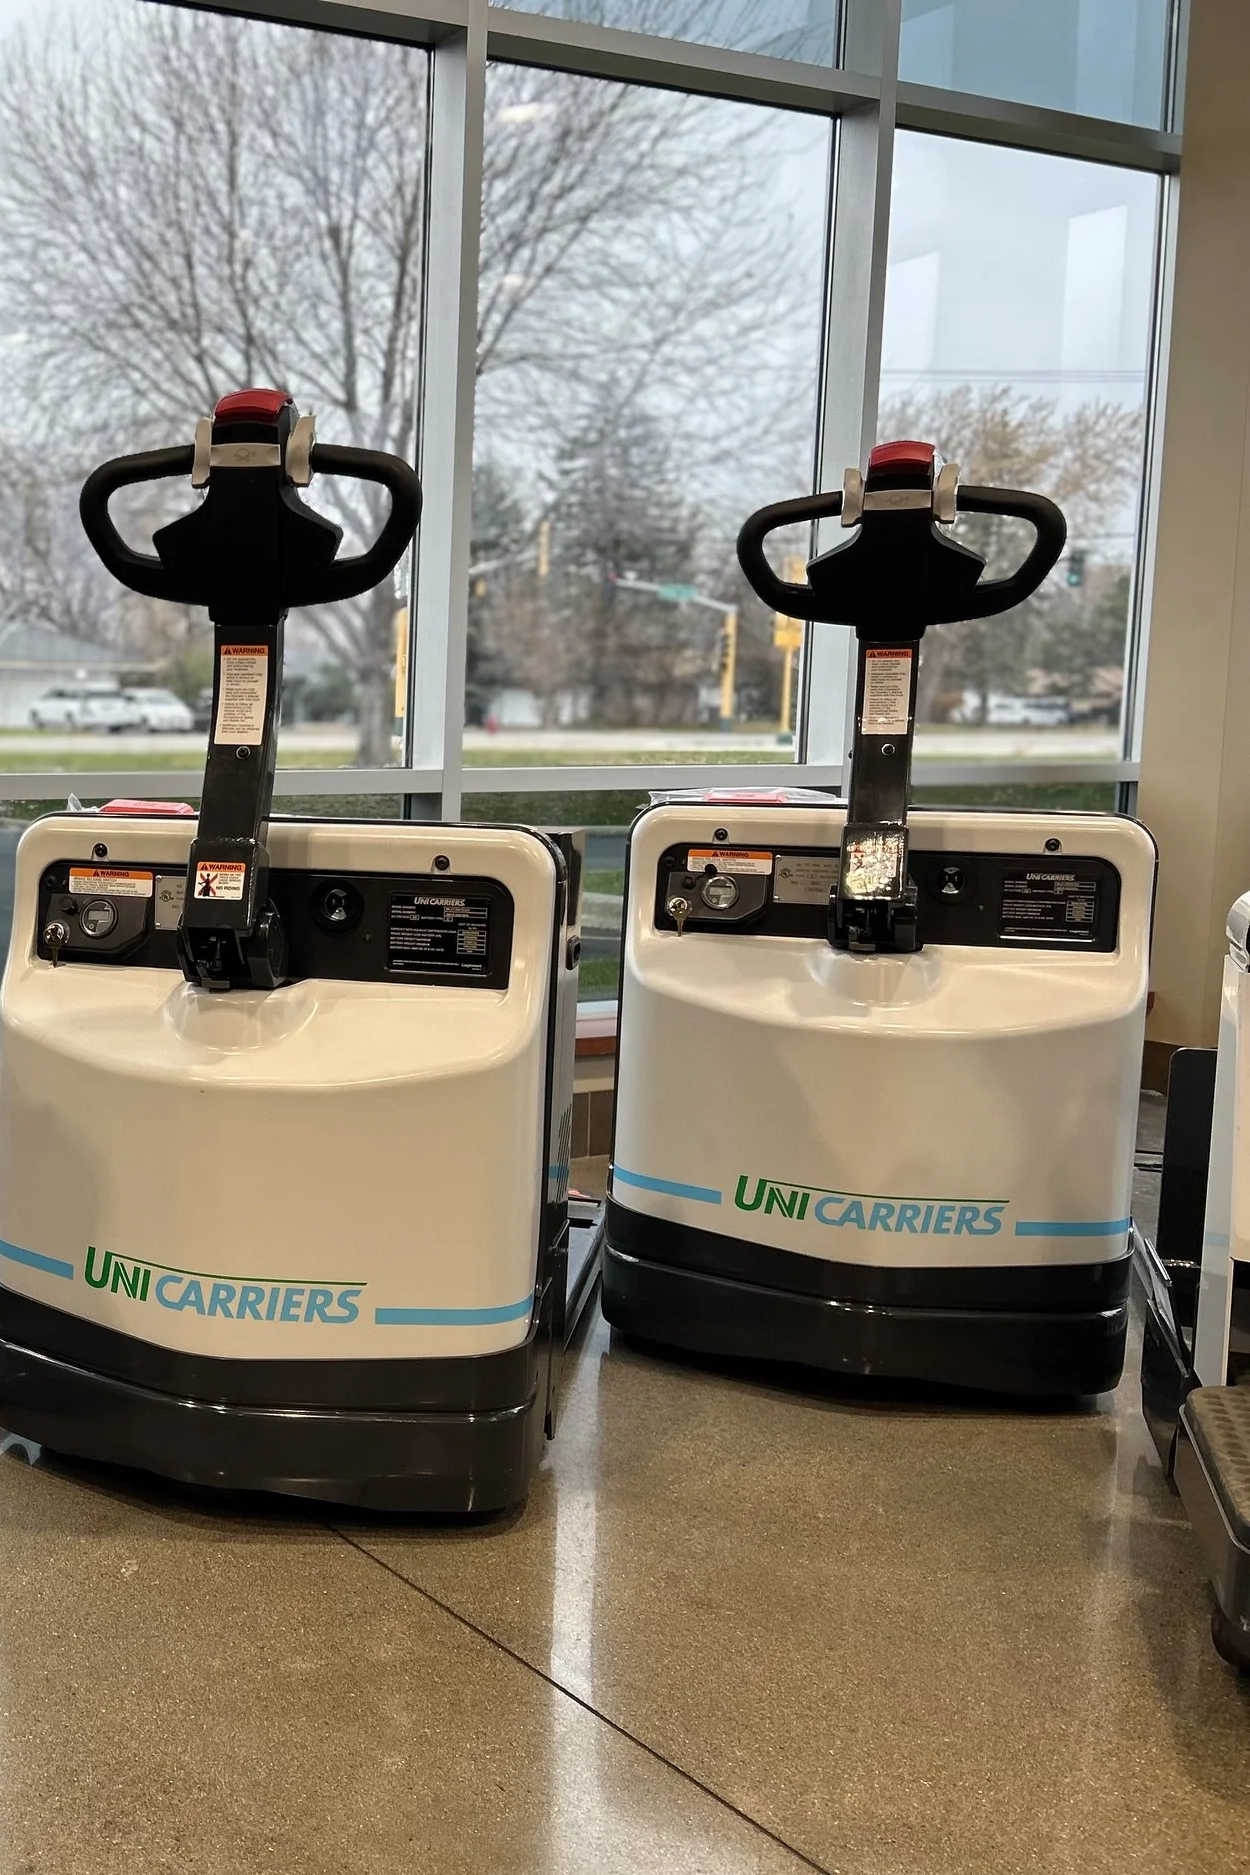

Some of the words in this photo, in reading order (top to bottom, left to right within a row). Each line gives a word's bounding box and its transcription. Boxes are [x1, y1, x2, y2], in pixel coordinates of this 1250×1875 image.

[100, 870, 130, 878] WARNING
[208, 863, 242, 871] WARNING
[733, 1175, 1007, 1236] UNICARRIERS
[84, 1246, 365, 1325] UNICARRIERS
